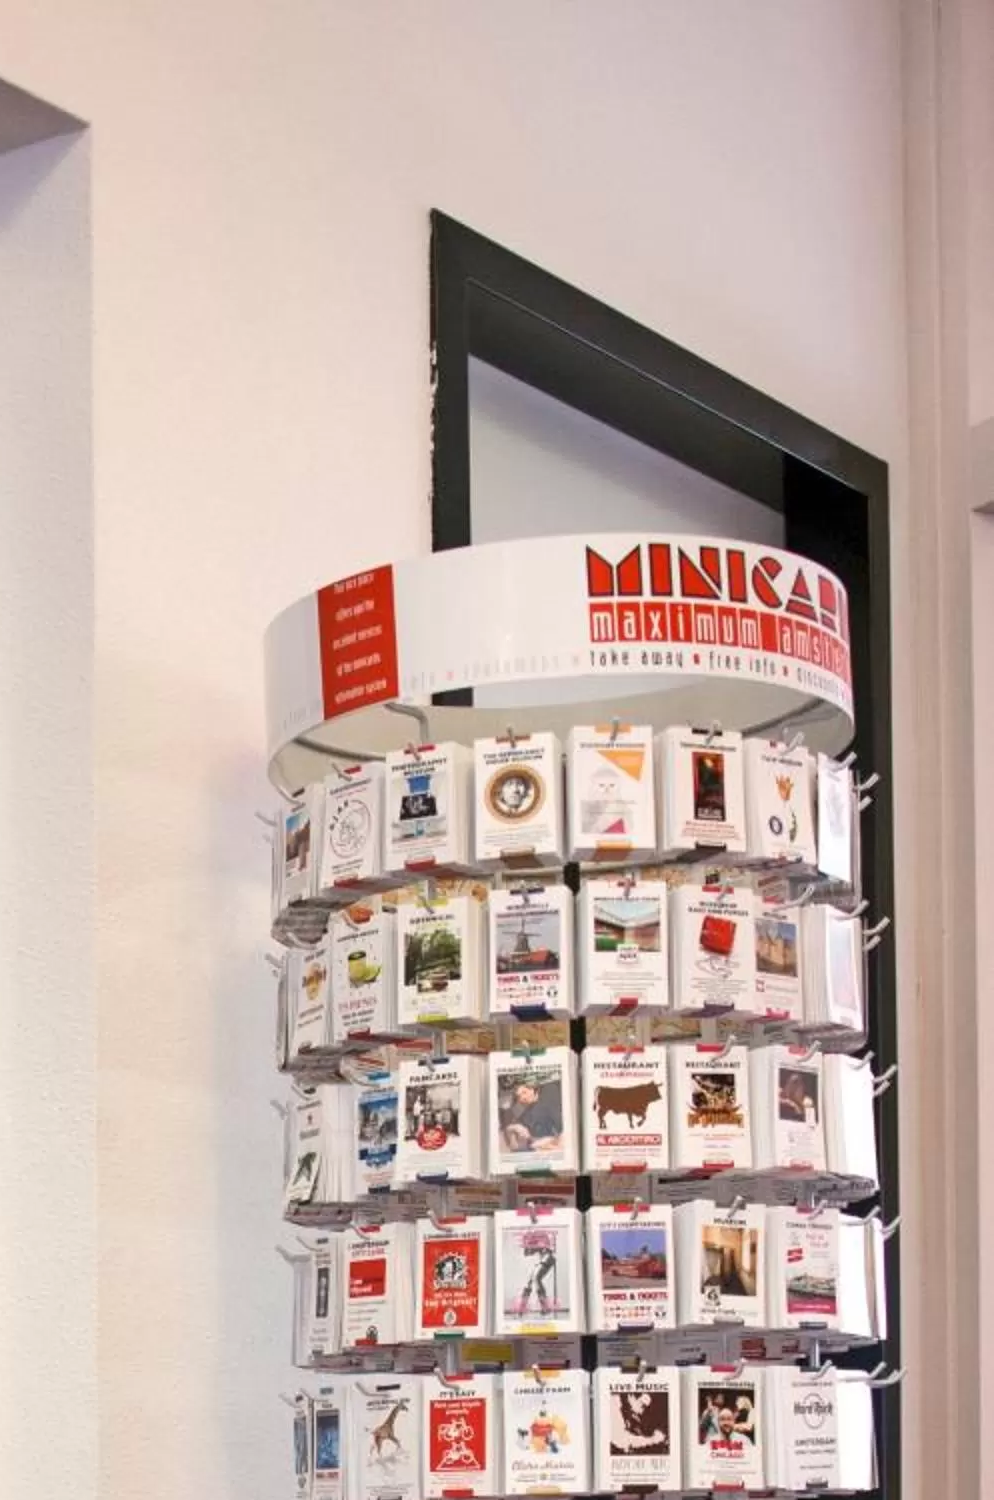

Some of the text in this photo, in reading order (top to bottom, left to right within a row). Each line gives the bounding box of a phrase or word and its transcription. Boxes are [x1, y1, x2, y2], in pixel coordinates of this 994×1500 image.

[592, 605, 761, 650] maximum
[590, 650, 628, 666] take
[641, 650, 683, 669] away
[709, 651, 741, 671] free
[593, 1061, 660, 1070] RESTAURANT
[685, 1061, 741, 1069] RESTAURANT
[609, 1383, 669, 1391] LIVE MUSIC
